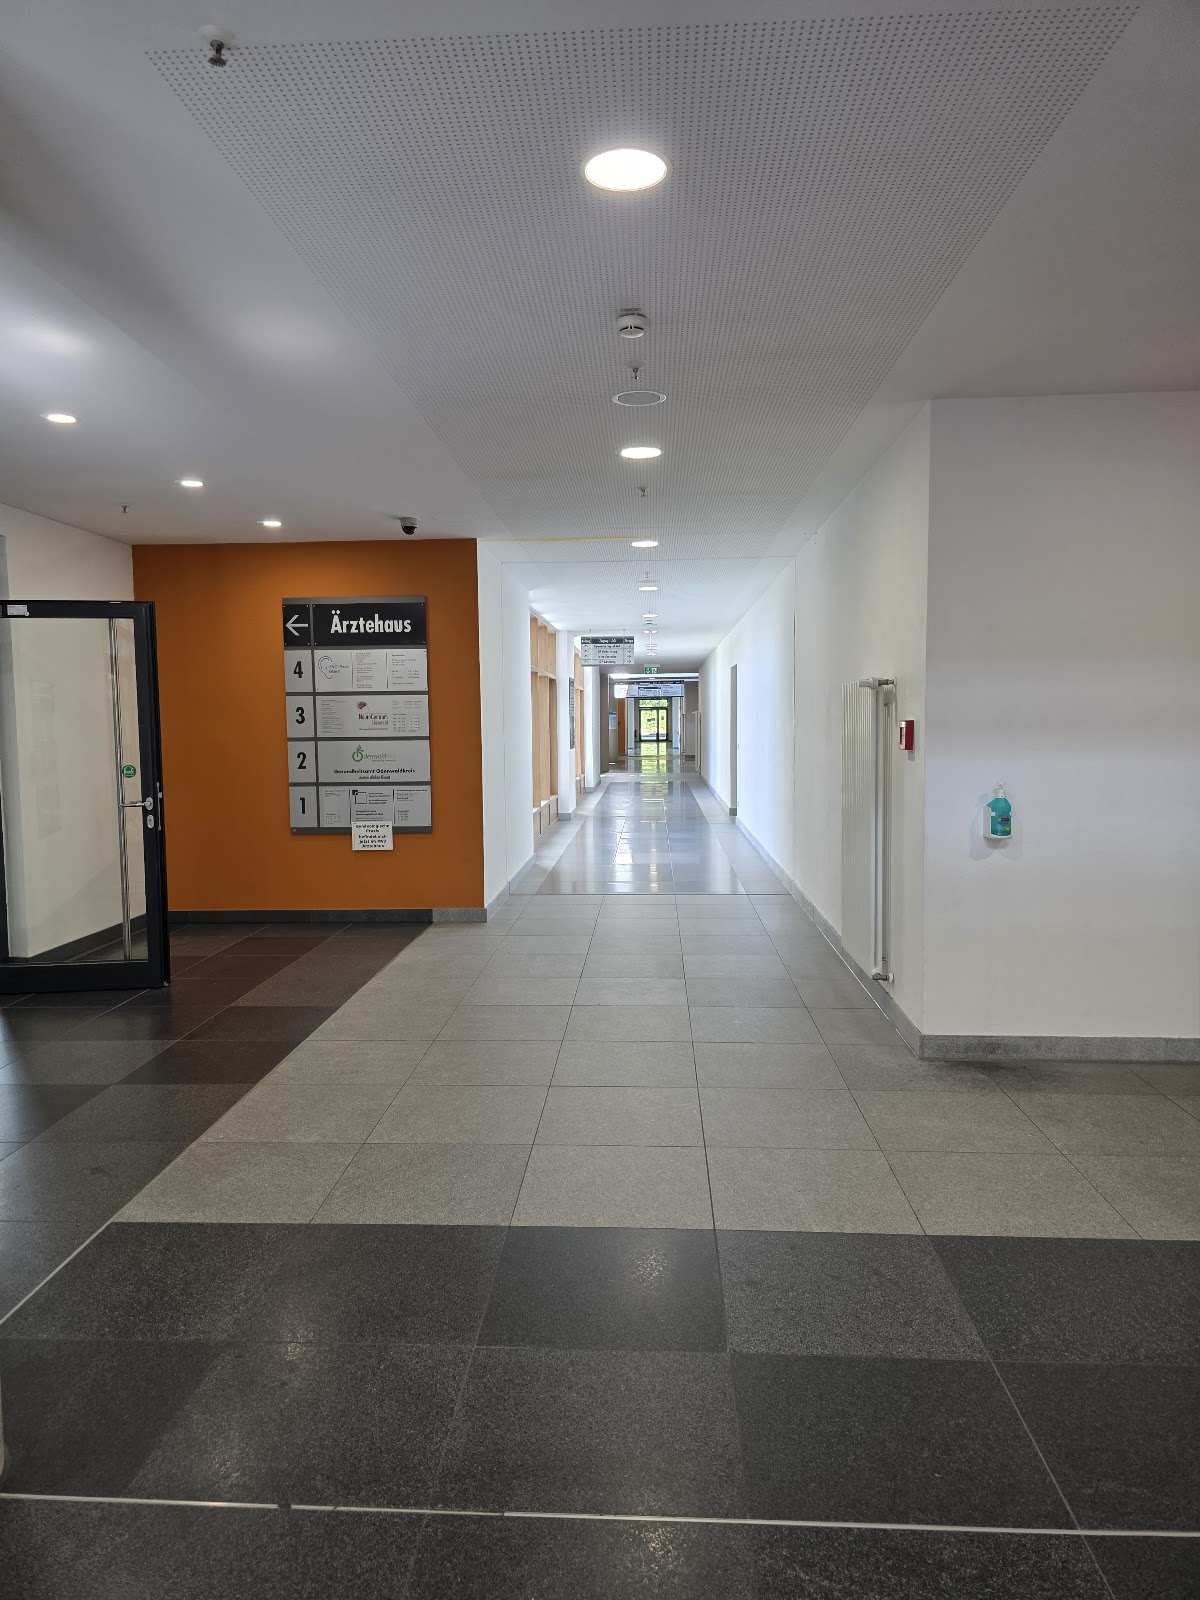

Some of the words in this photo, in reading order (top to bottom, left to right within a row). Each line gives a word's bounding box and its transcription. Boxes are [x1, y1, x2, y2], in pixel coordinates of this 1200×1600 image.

[330, 609, 412, 634] Ärztehaus
[293, 660, 304, 679] 4
[295, 706, 306, 725] 3
[296, 751, 307, 770] 2
[299, 797, 306, 815] 1
